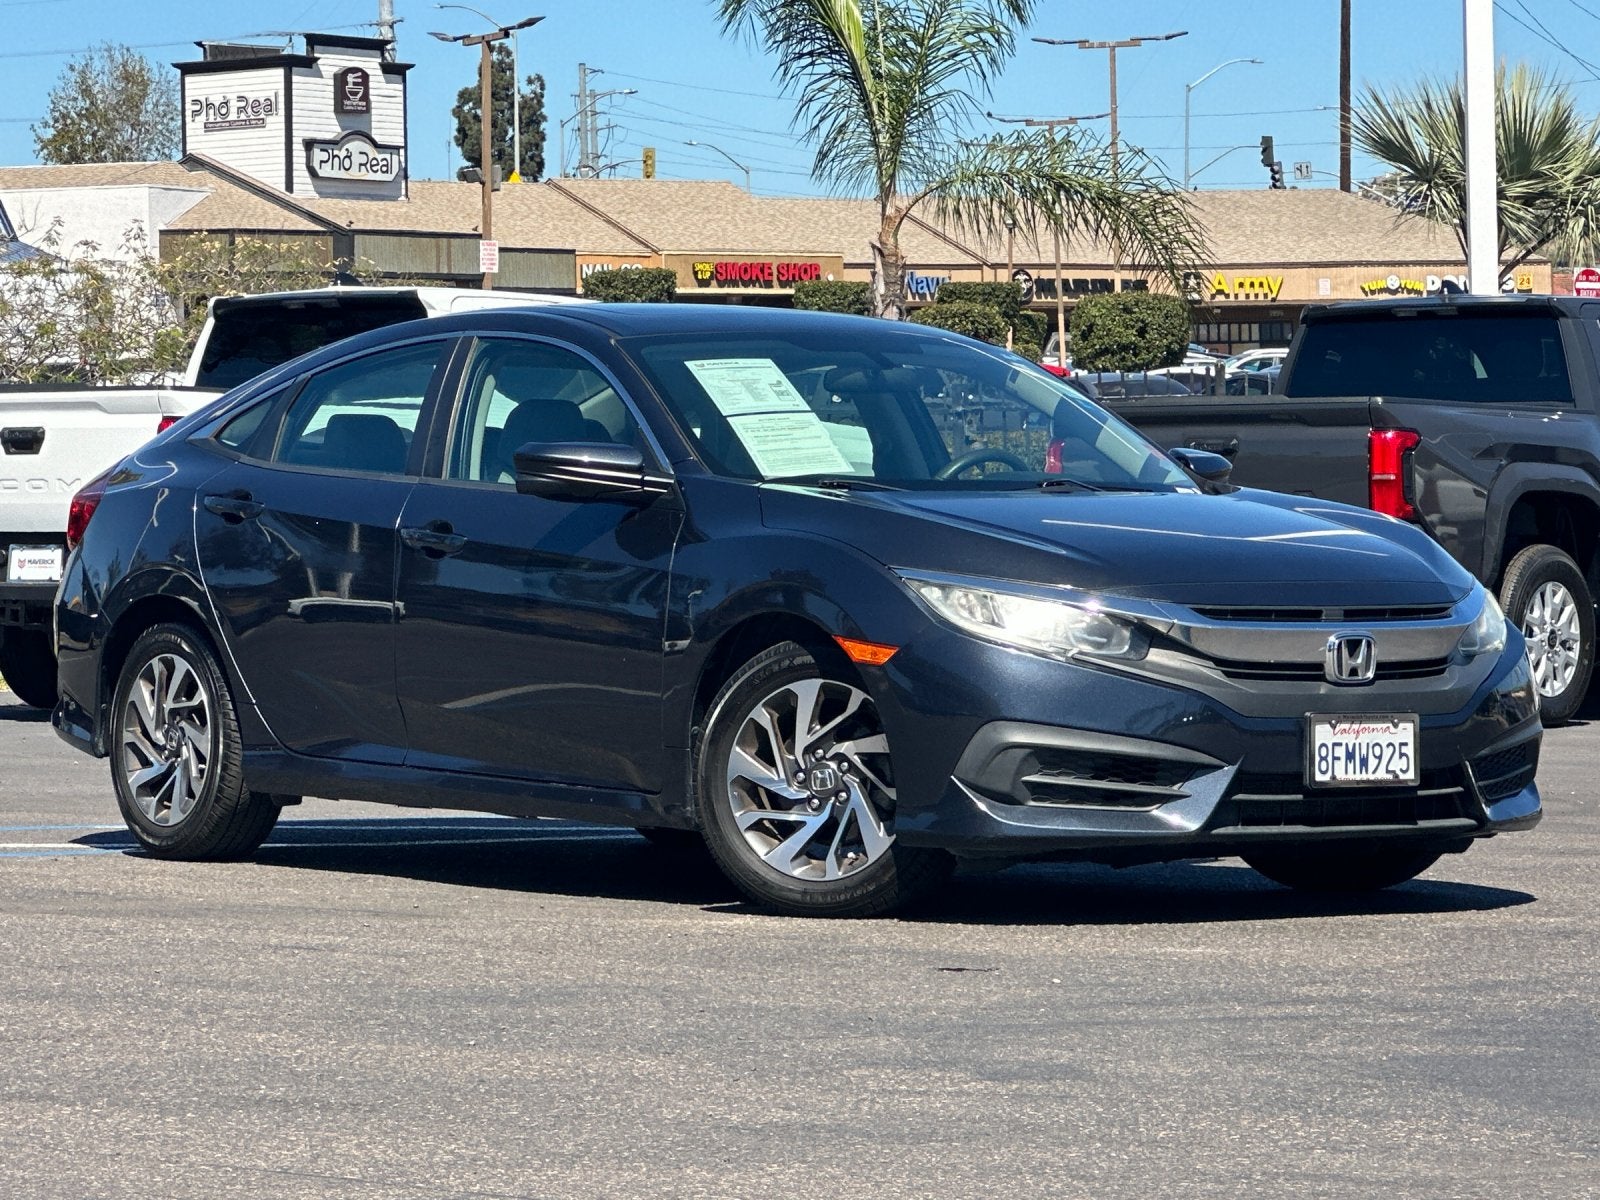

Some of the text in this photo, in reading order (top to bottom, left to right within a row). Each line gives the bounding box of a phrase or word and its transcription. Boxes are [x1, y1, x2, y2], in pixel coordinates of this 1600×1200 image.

[236, 91, 279, 118] Real
[319, 148, 393, 174] Phở Real
[694, 262, 713, 271] SMOKE
[703, 271, 710, 279] UP
[716, 262, 821, 280] SMOKE SHOP
[1210, 272, 1283, 298] Army
[1362, 279, 1387, 291] YUM
[1400, 279, 1425, 292] YUM
[1519, 277, 1530, 285] 24
[1332, 720, 1397, 740] California
[1317, 742, 1410, 775] 8FMW925
